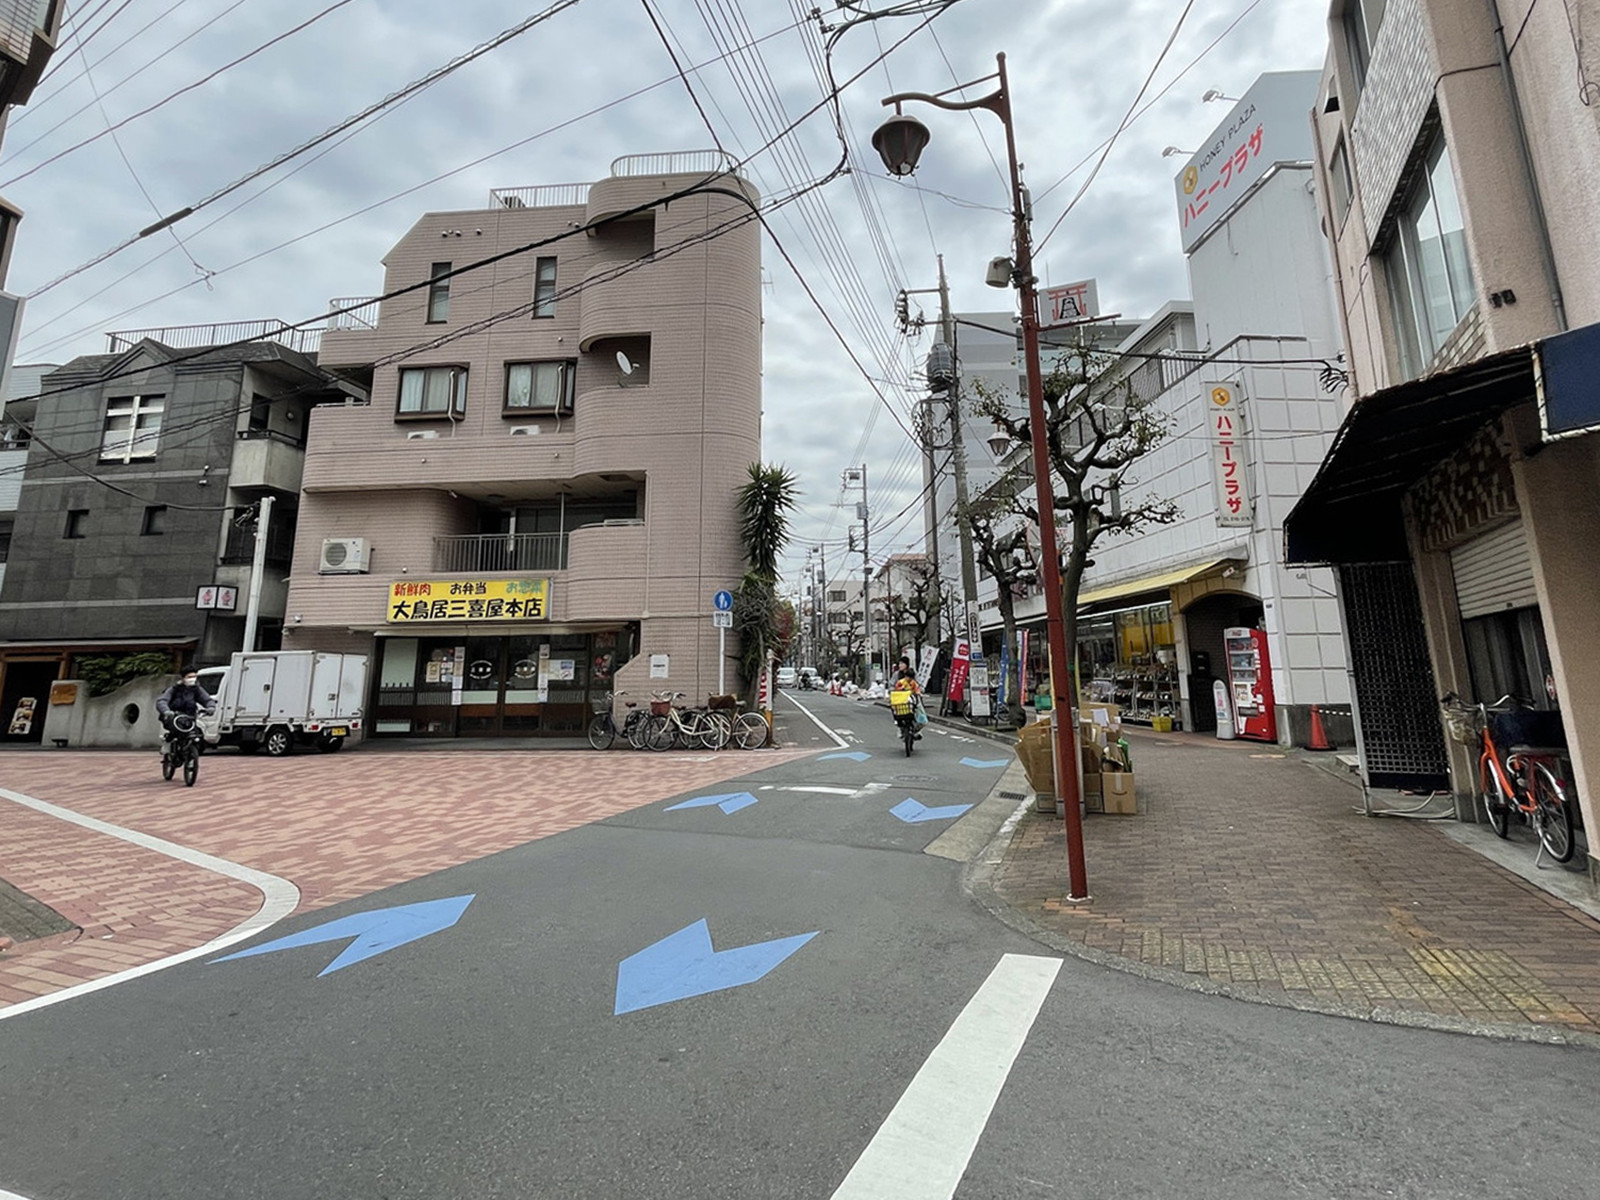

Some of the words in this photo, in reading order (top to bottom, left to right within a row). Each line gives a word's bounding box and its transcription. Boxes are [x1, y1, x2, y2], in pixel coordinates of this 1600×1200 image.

[1200, 135, 1226, 172] HONEY
[1228, 104, 1257, 140] PLAZA
[1184, 123, 1264, 229] ハニープラザ
[1217, 416, 1242, 514] ハニープラザ
[392, 598, 542, 619] 大鳥居三喜屋本店
[394, 582, 431, 596] 新鮮肉
[450, 581, 487, 595] お弁当
